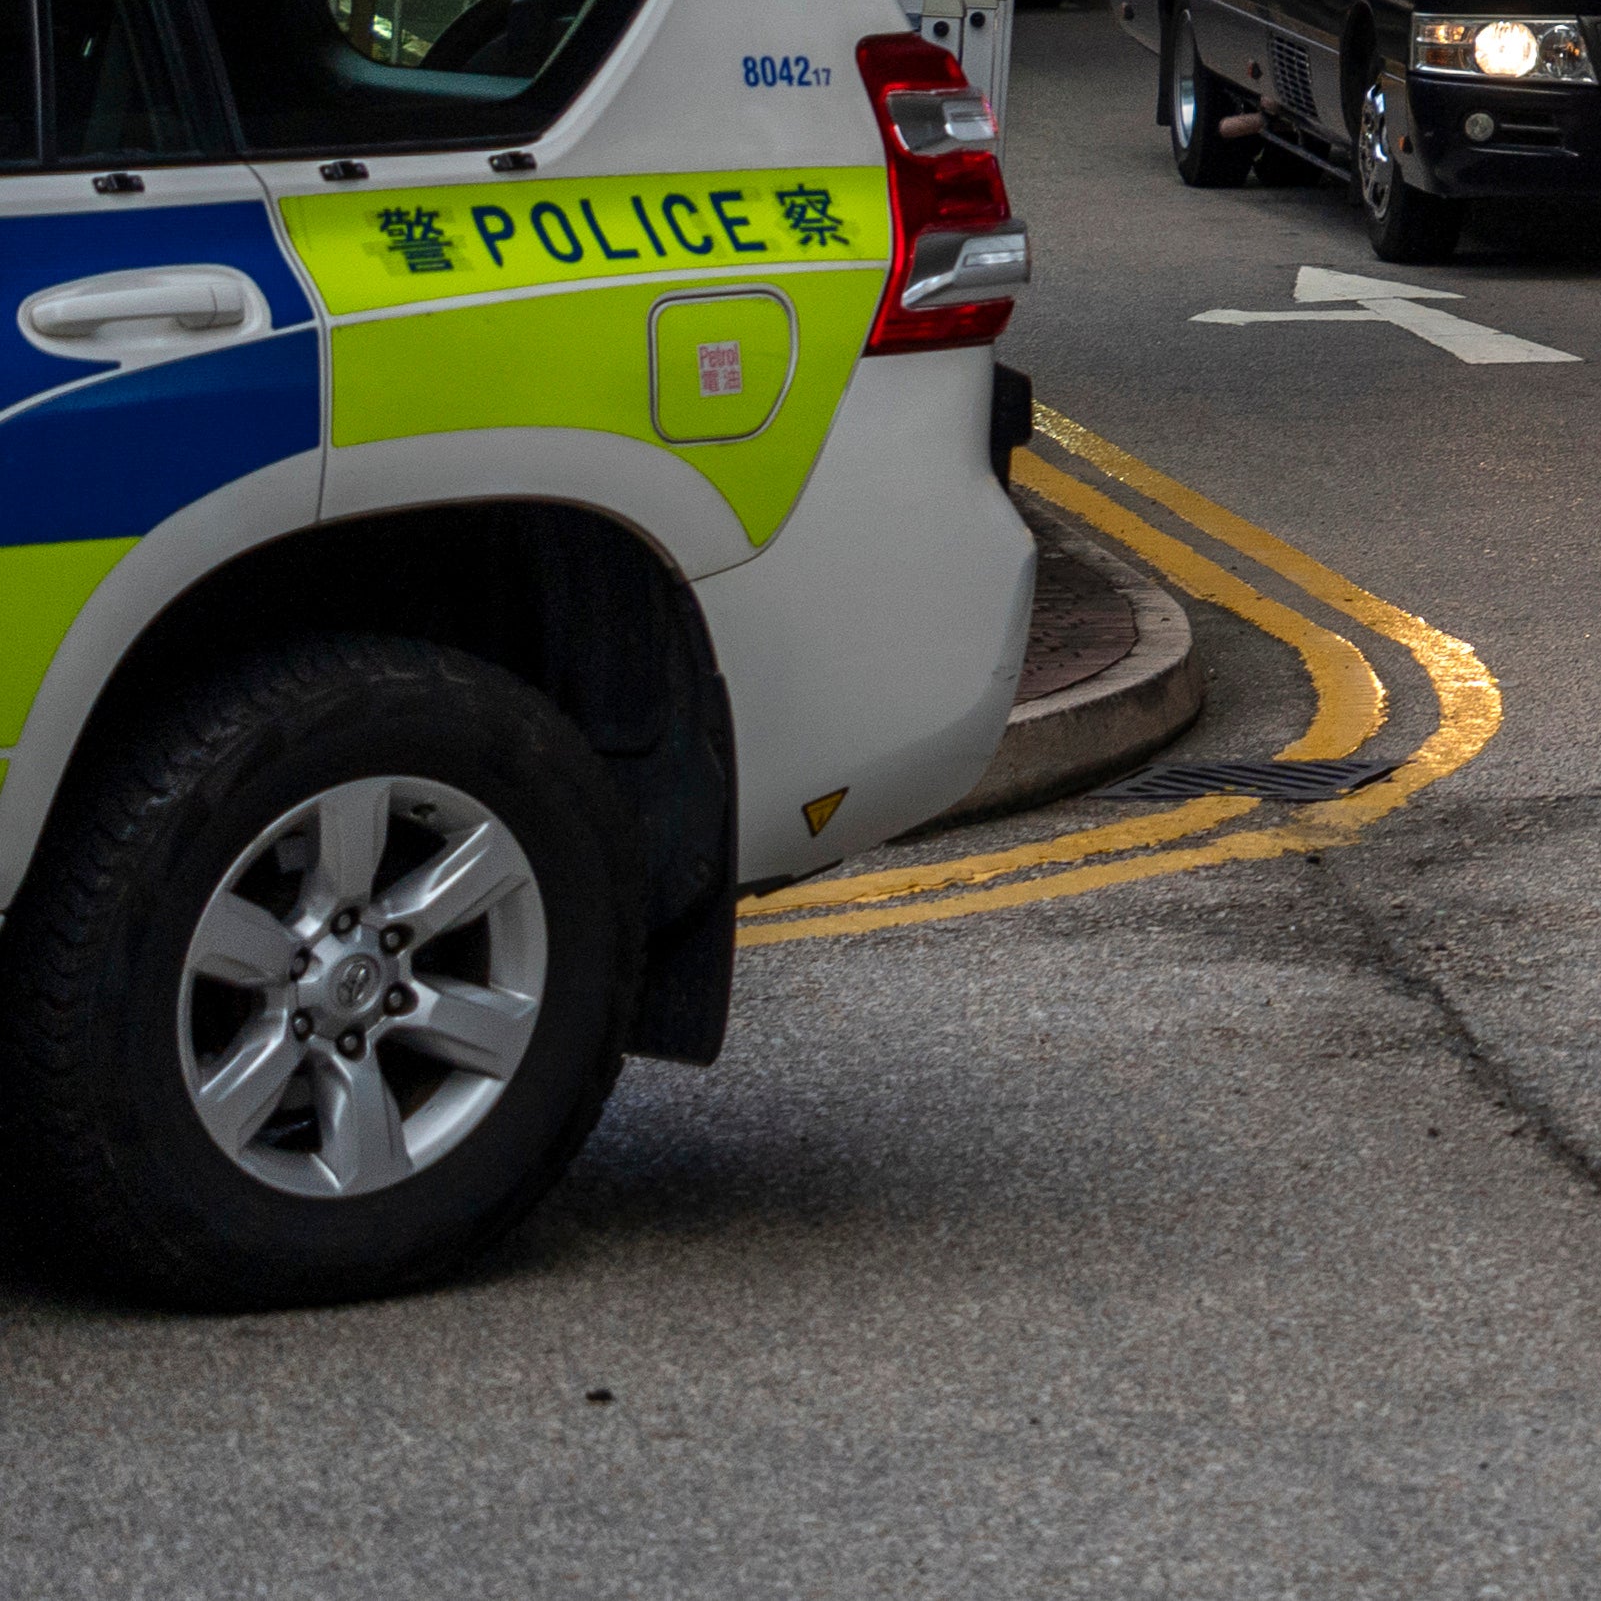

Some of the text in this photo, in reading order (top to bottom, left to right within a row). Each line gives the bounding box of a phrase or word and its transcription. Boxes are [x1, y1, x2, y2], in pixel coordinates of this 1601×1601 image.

[742, 55, 812, 88] 8042
[377, 182, 850, 274] 警 POLICE 察
